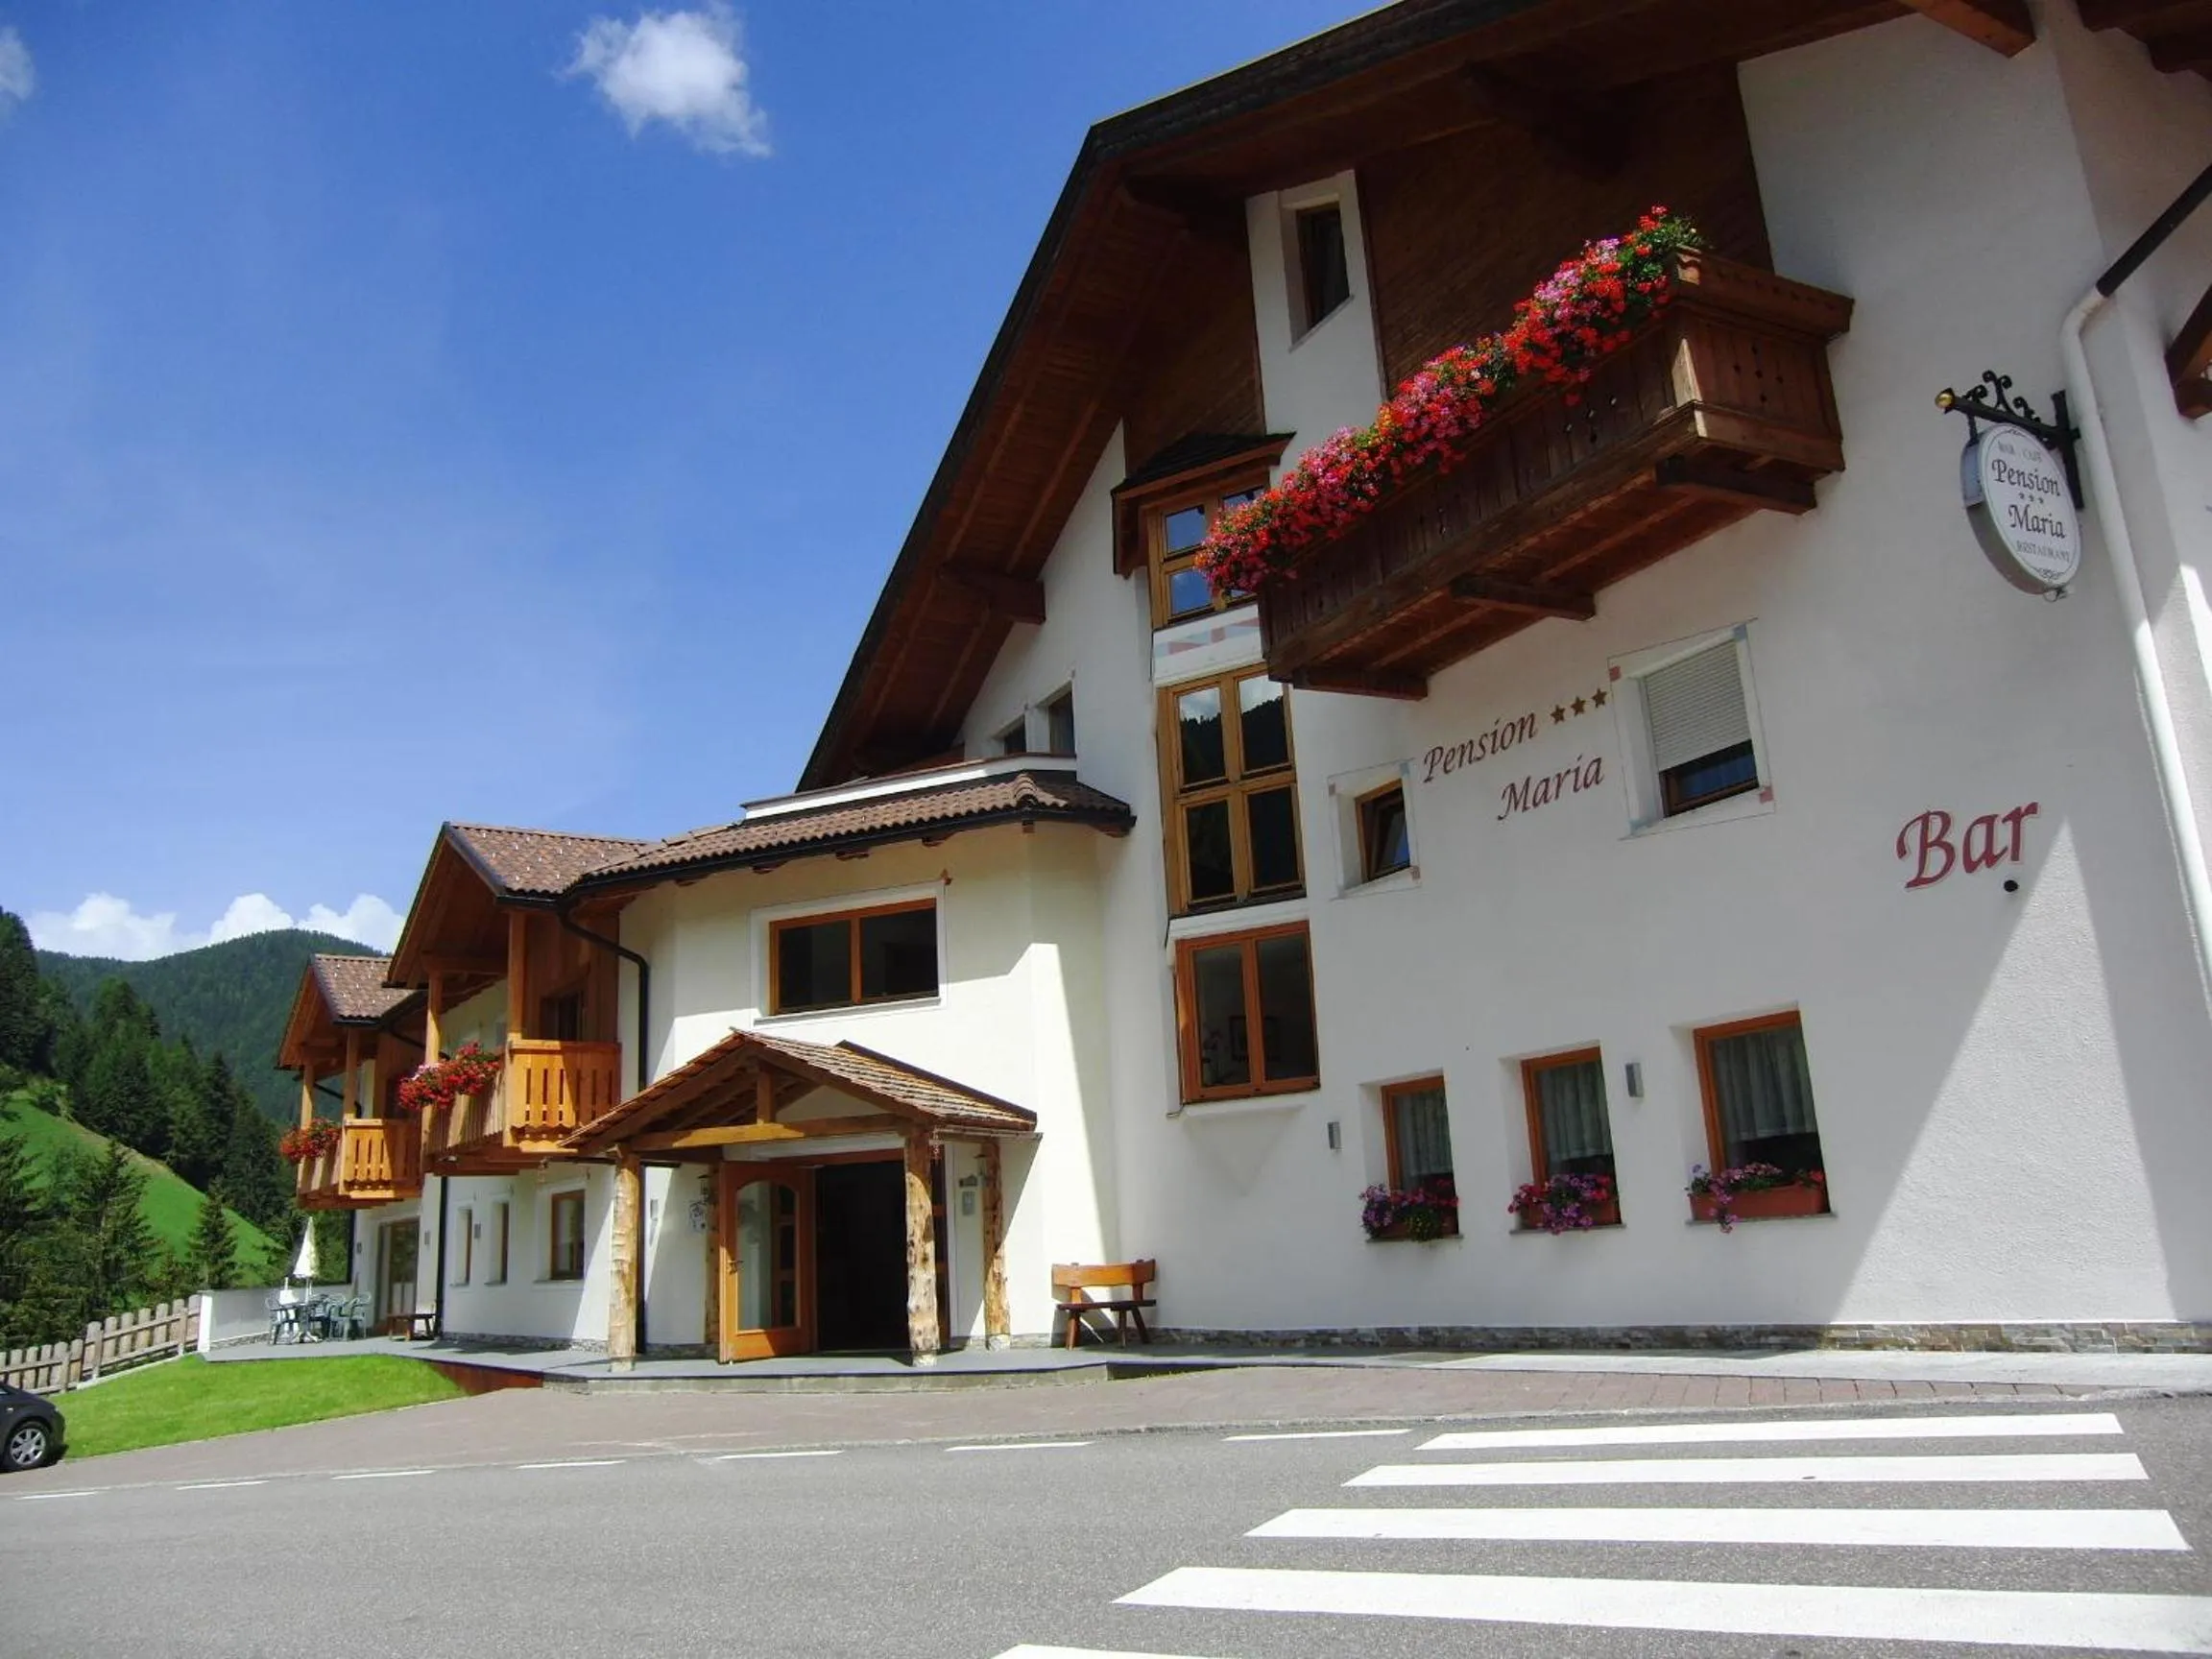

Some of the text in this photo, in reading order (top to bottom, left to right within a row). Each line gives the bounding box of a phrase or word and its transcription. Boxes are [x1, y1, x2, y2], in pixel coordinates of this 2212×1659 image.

[1991, 459, 2060, 496] Pension
[2008, 504, 2066, 539] Maria
[1423, 711, 1536, 783] Pension
[1497, 754, 1604, 821] Maria
[1896, 802, 2038, 888] Bar
